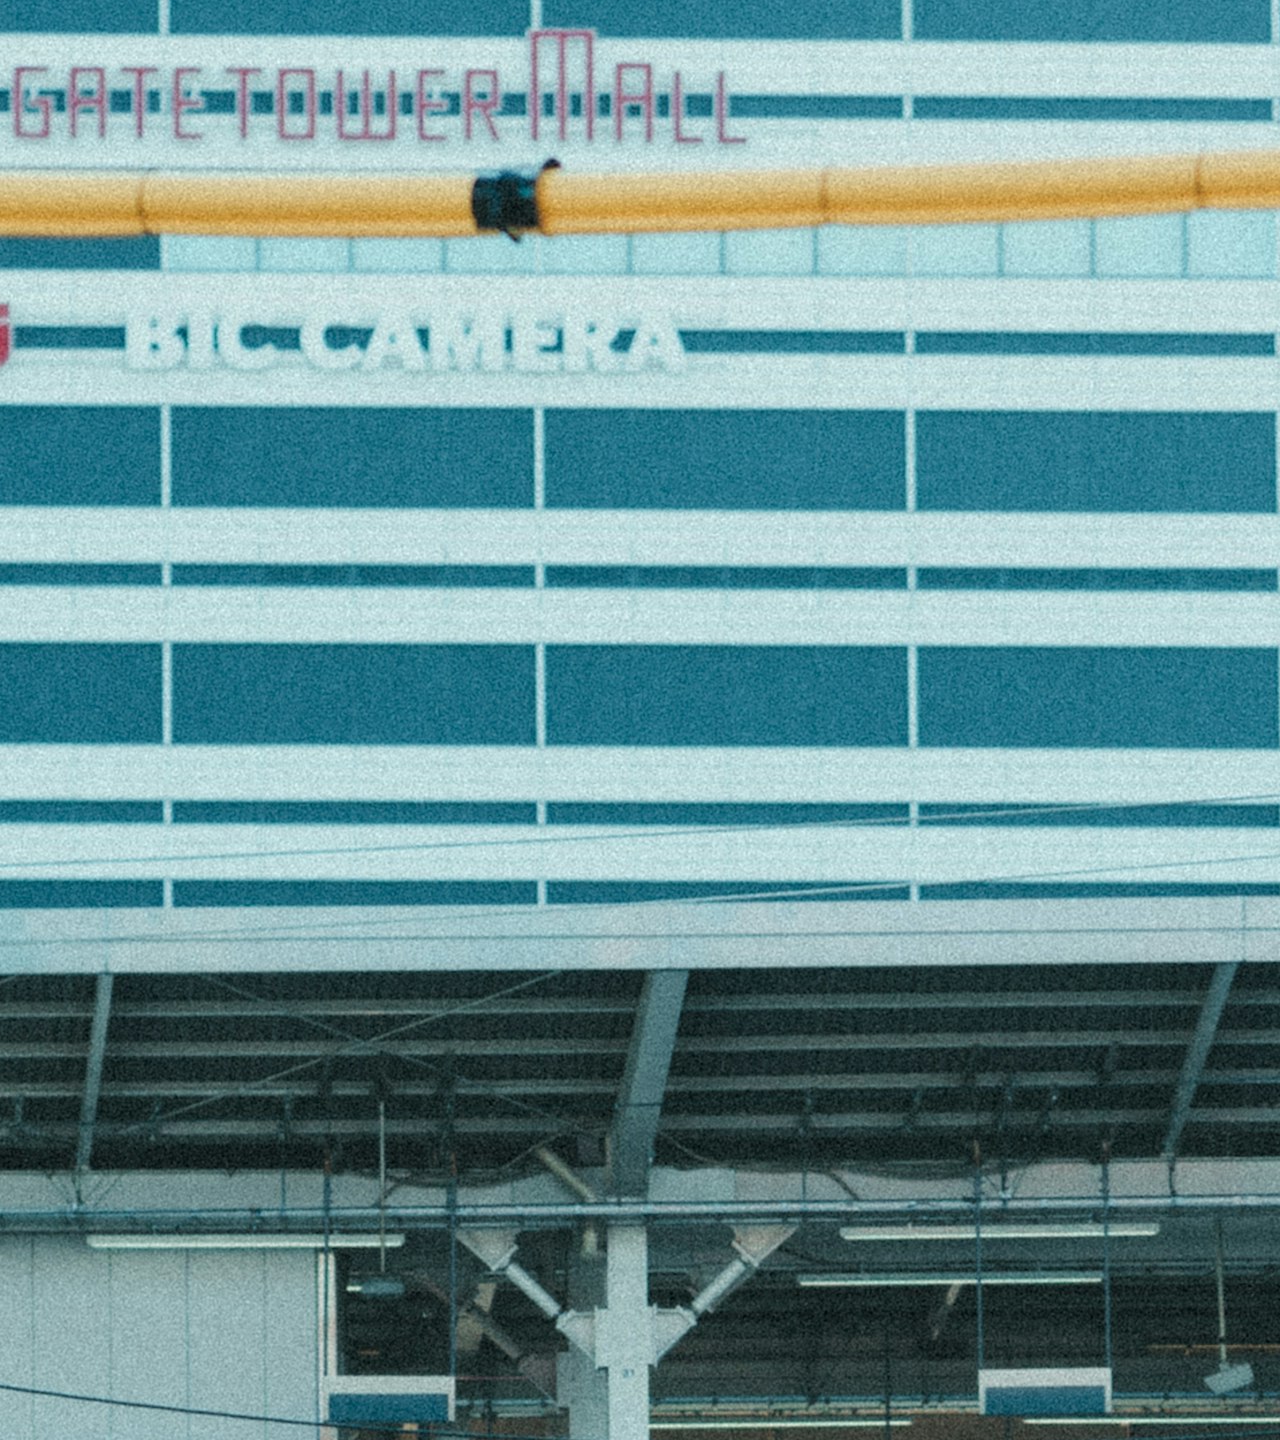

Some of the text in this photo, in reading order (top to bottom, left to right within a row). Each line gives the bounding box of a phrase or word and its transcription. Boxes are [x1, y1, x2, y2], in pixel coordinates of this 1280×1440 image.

[526, 29, 748, 146] MALL
[122, 313, 687, 376] BIC CAMERA
